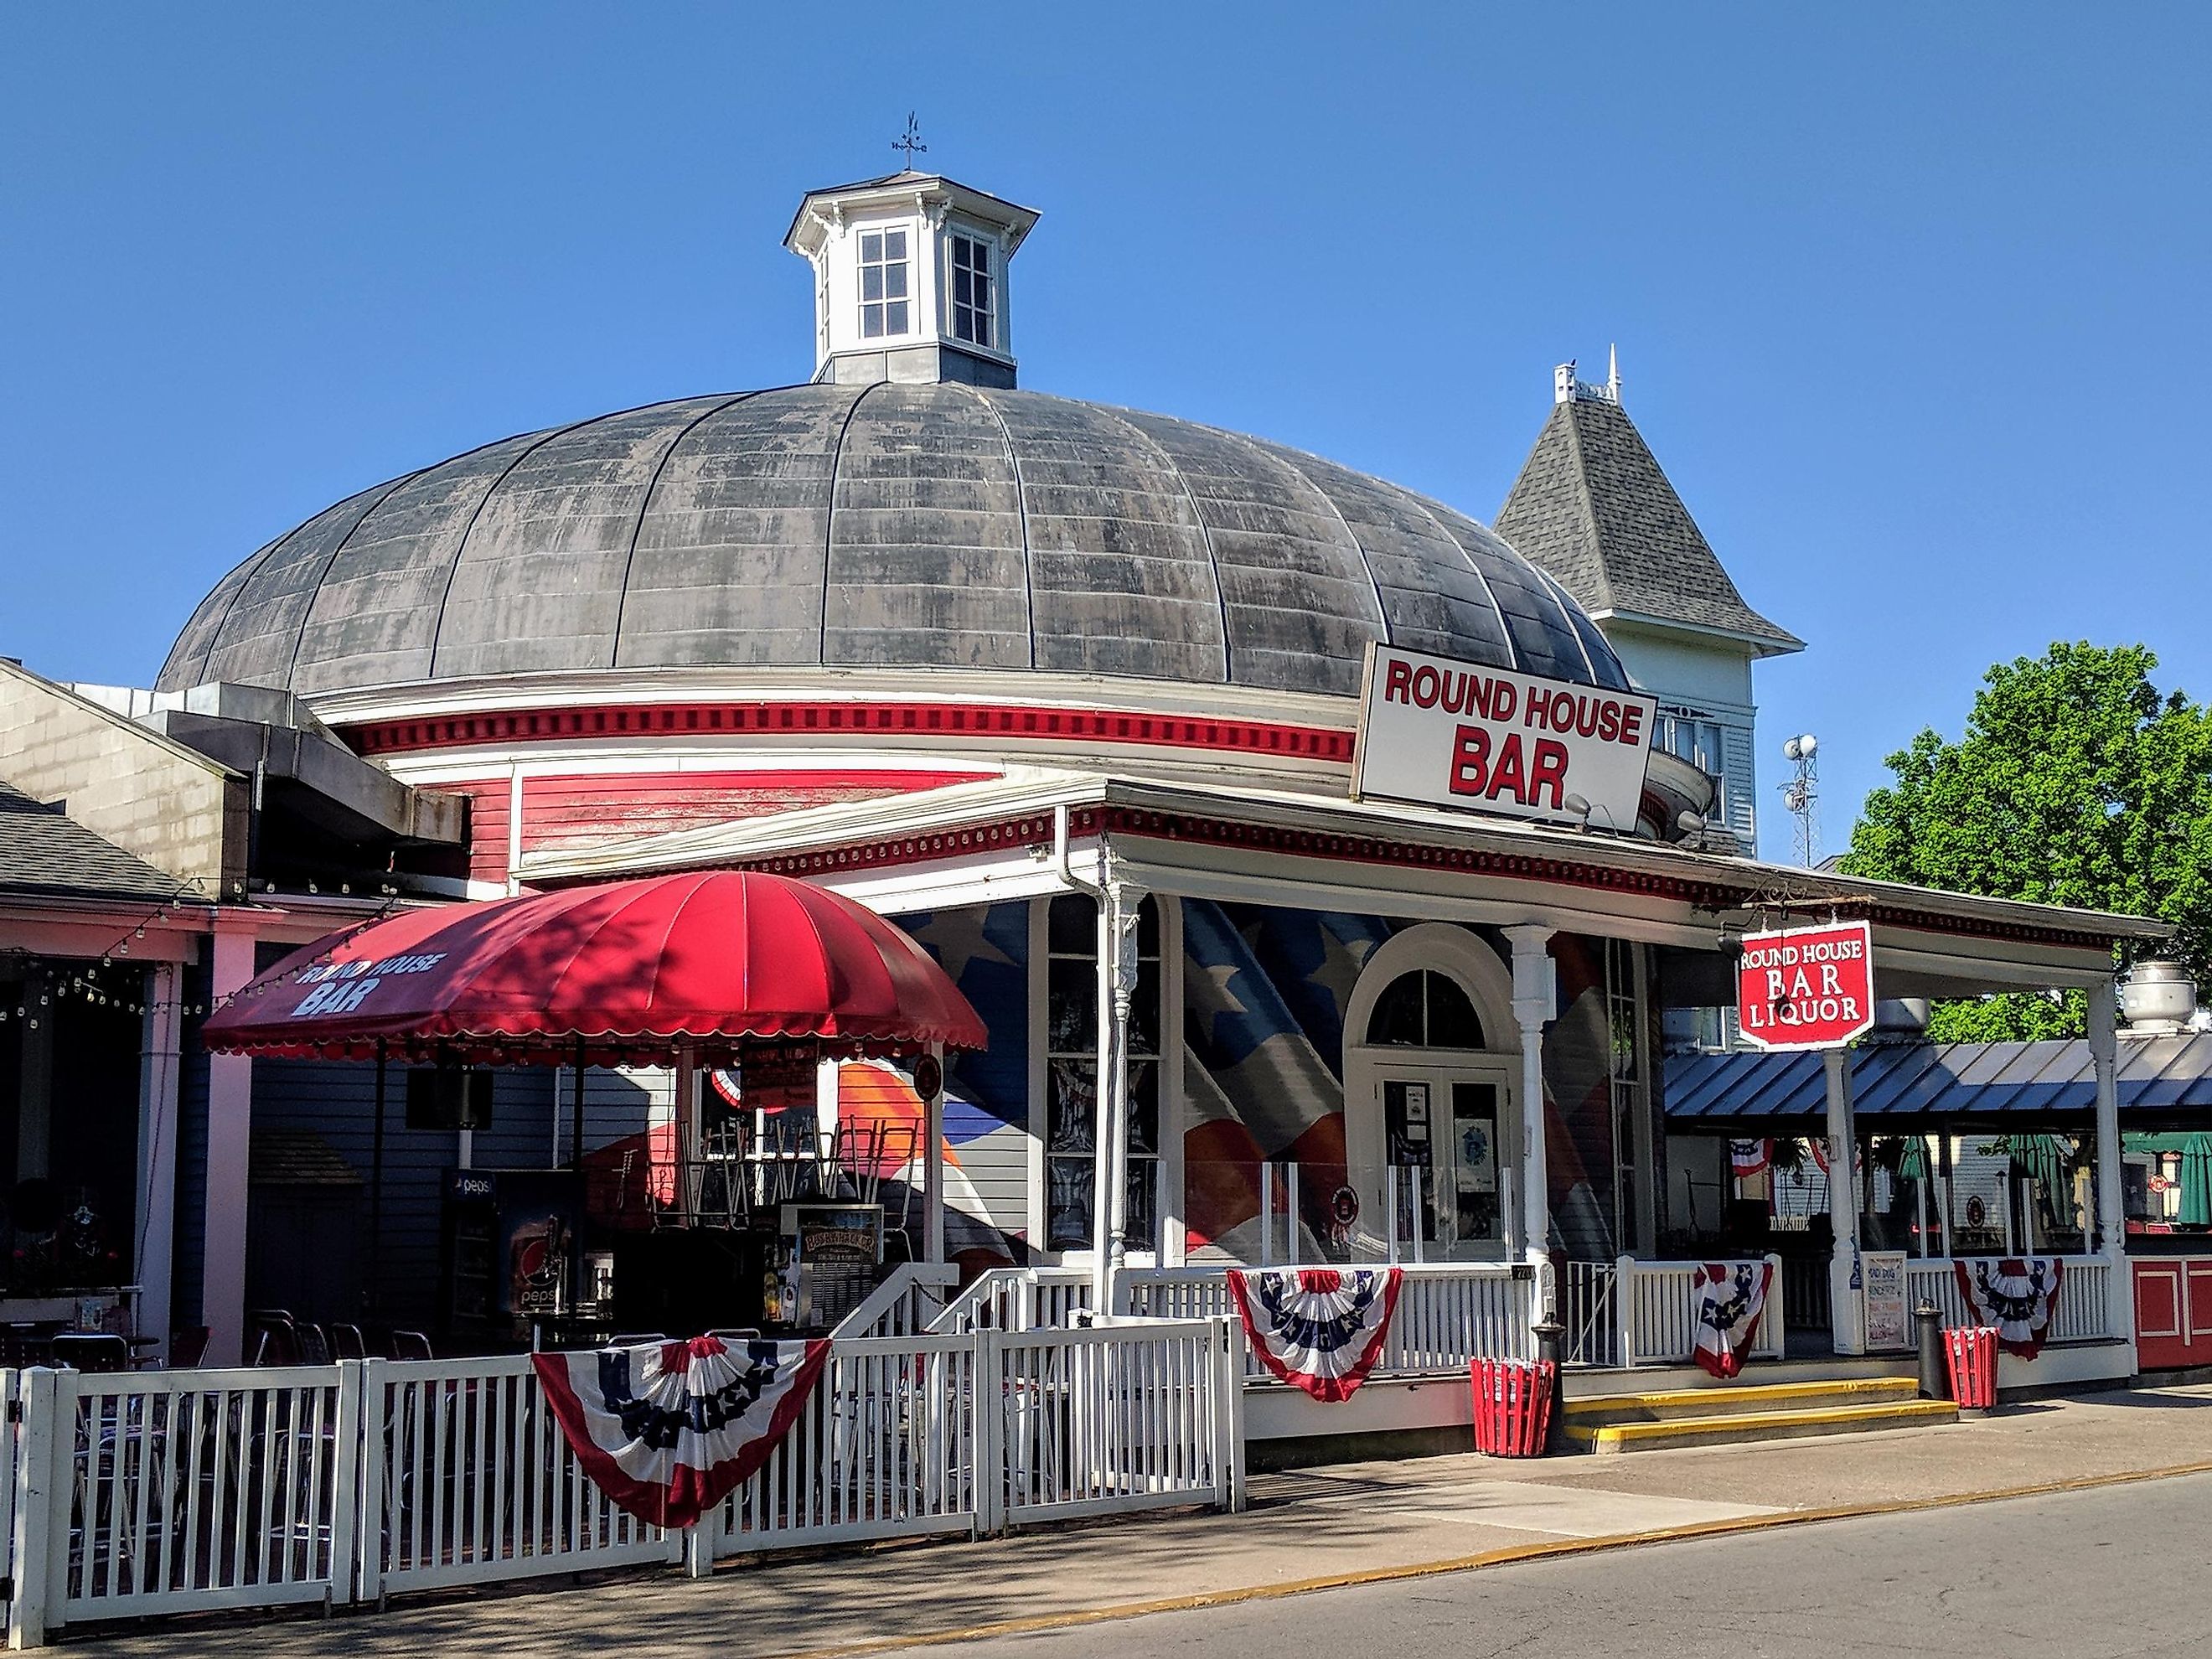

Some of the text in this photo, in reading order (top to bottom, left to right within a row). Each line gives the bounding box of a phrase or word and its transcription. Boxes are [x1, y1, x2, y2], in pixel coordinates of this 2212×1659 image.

[1385, 659, 1643, 746] ROUND HOUSE
[1449, 724, 1569, 810] BAR
[295, 953, 448, 985] ROUND HOUSE
[1740, 940, 1862, 970] ROUND HOUSE
[291, 978, 380, 1017] BAR
[1766, 964, 1843, 1000] BAR
[1749, 997, 1860, 1028] LIQUOR
[463, 1179, 490, 1195] peps
[521, 1289, 556, 1305] peps
